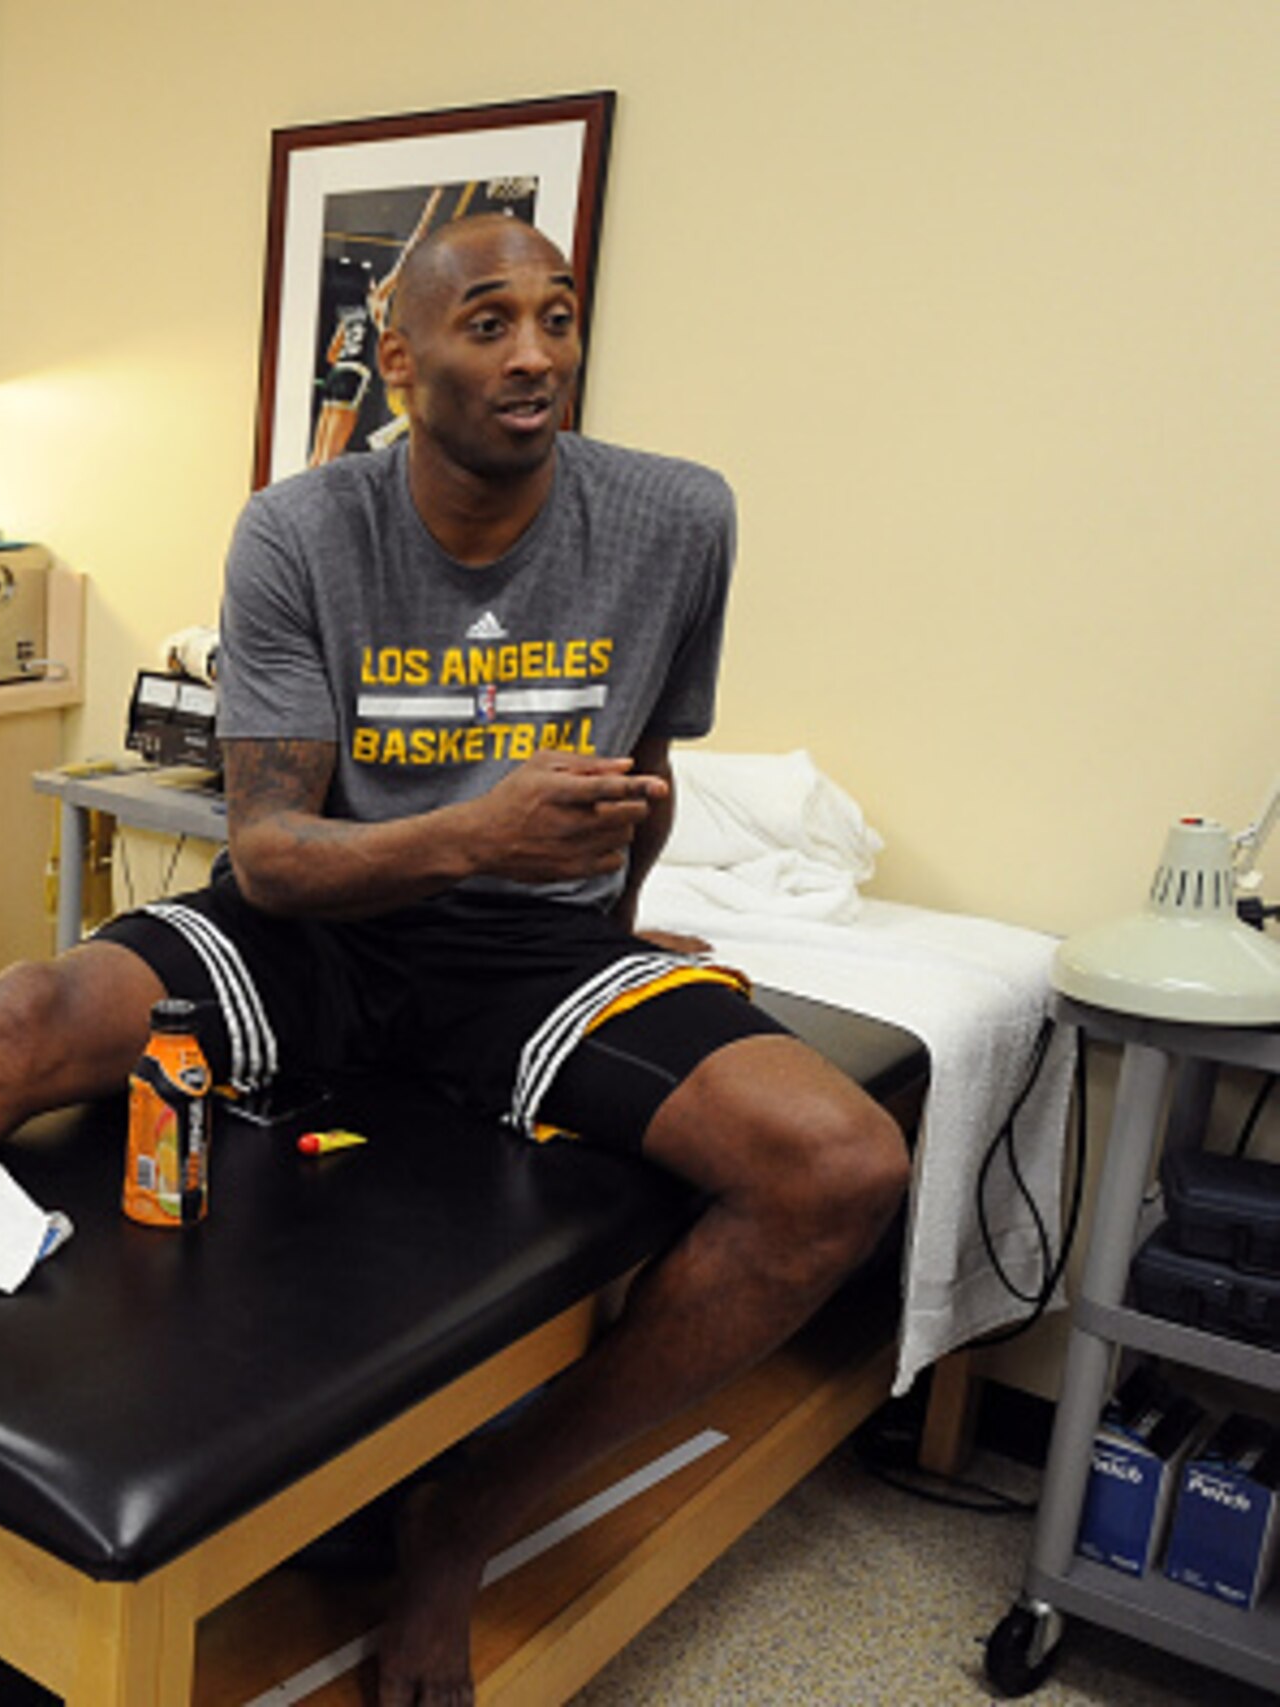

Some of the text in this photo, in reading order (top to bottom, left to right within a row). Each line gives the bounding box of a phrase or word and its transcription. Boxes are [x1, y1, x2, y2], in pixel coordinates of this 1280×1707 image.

[361, 637, 613, 685] LOS ANGELES
[352, 716, 596, 765] BASKETBALL
